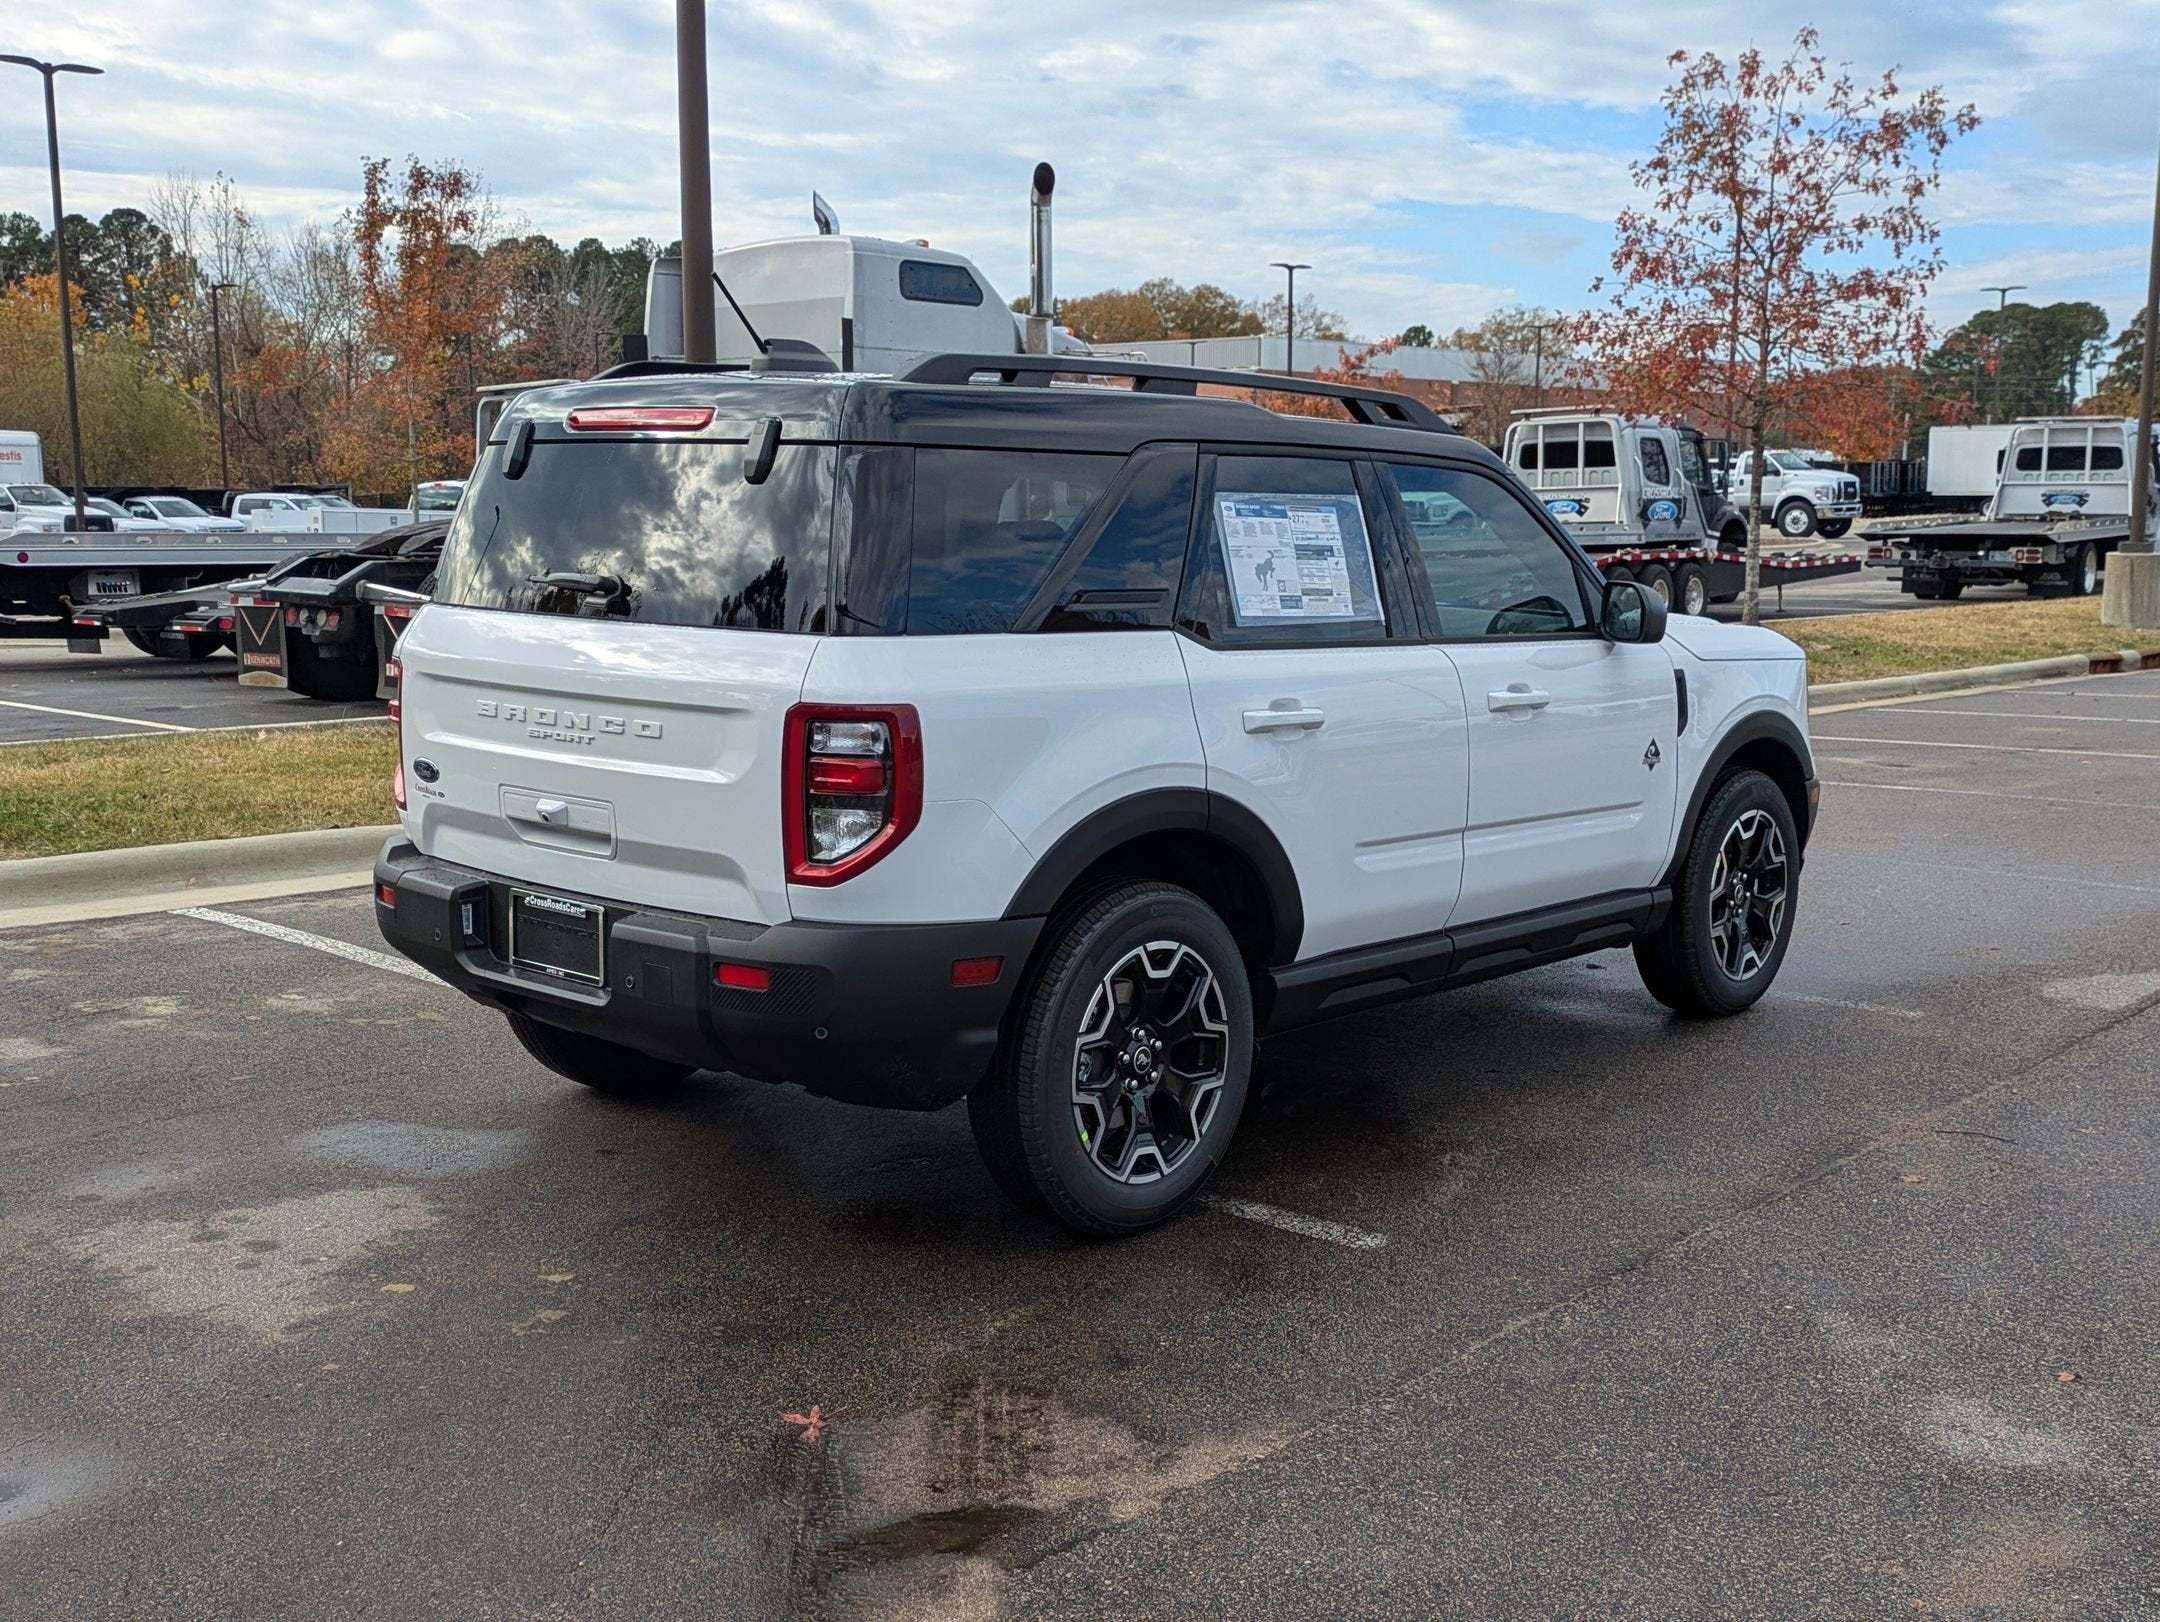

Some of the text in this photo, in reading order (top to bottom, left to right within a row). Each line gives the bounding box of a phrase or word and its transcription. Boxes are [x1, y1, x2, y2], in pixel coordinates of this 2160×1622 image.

[1550, 501, 1575, 514] Ford
[1651, 502, 1674, 521] Ford
[250, 655, 281, 665] KENWORTH
[476, 699, 662, 739] BRONCO
[527, 727, 595, 745] SPORT
